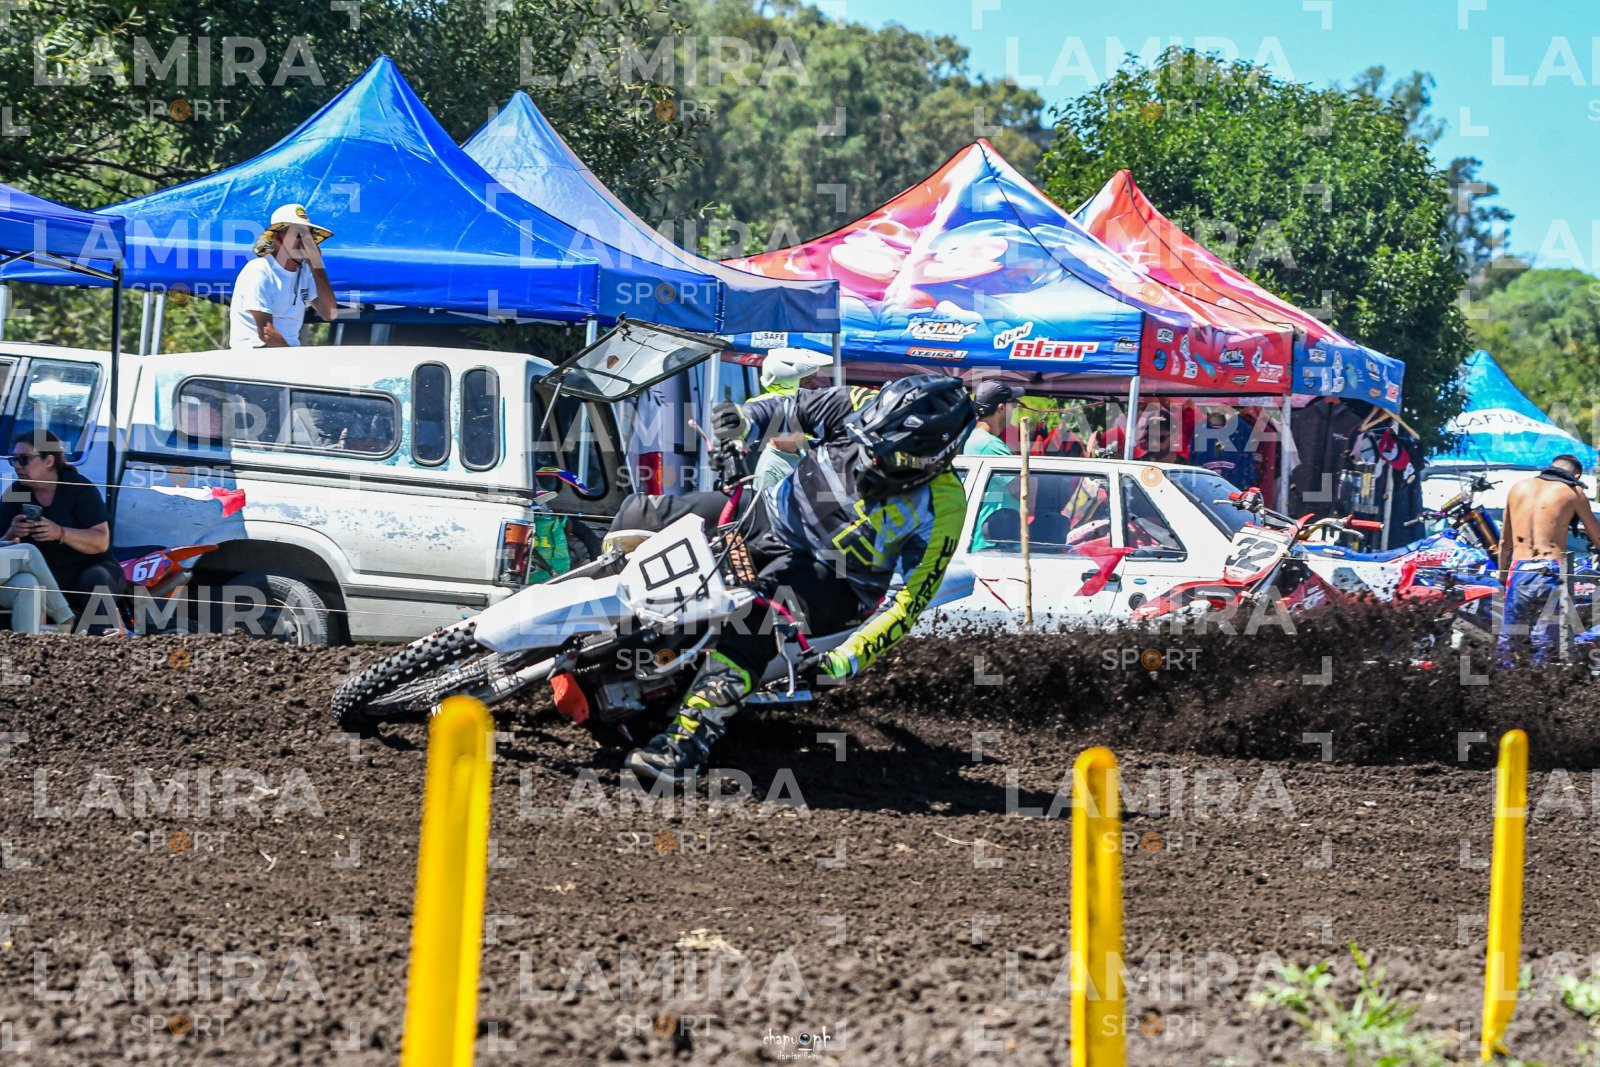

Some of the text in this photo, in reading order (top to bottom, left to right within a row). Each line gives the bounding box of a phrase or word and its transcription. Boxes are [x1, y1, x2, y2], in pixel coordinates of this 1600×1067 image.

[763, 331, 785, 341] SAFE
[1225, 536, 1278, 573] 32
[132, 557, 162, 582] 67
